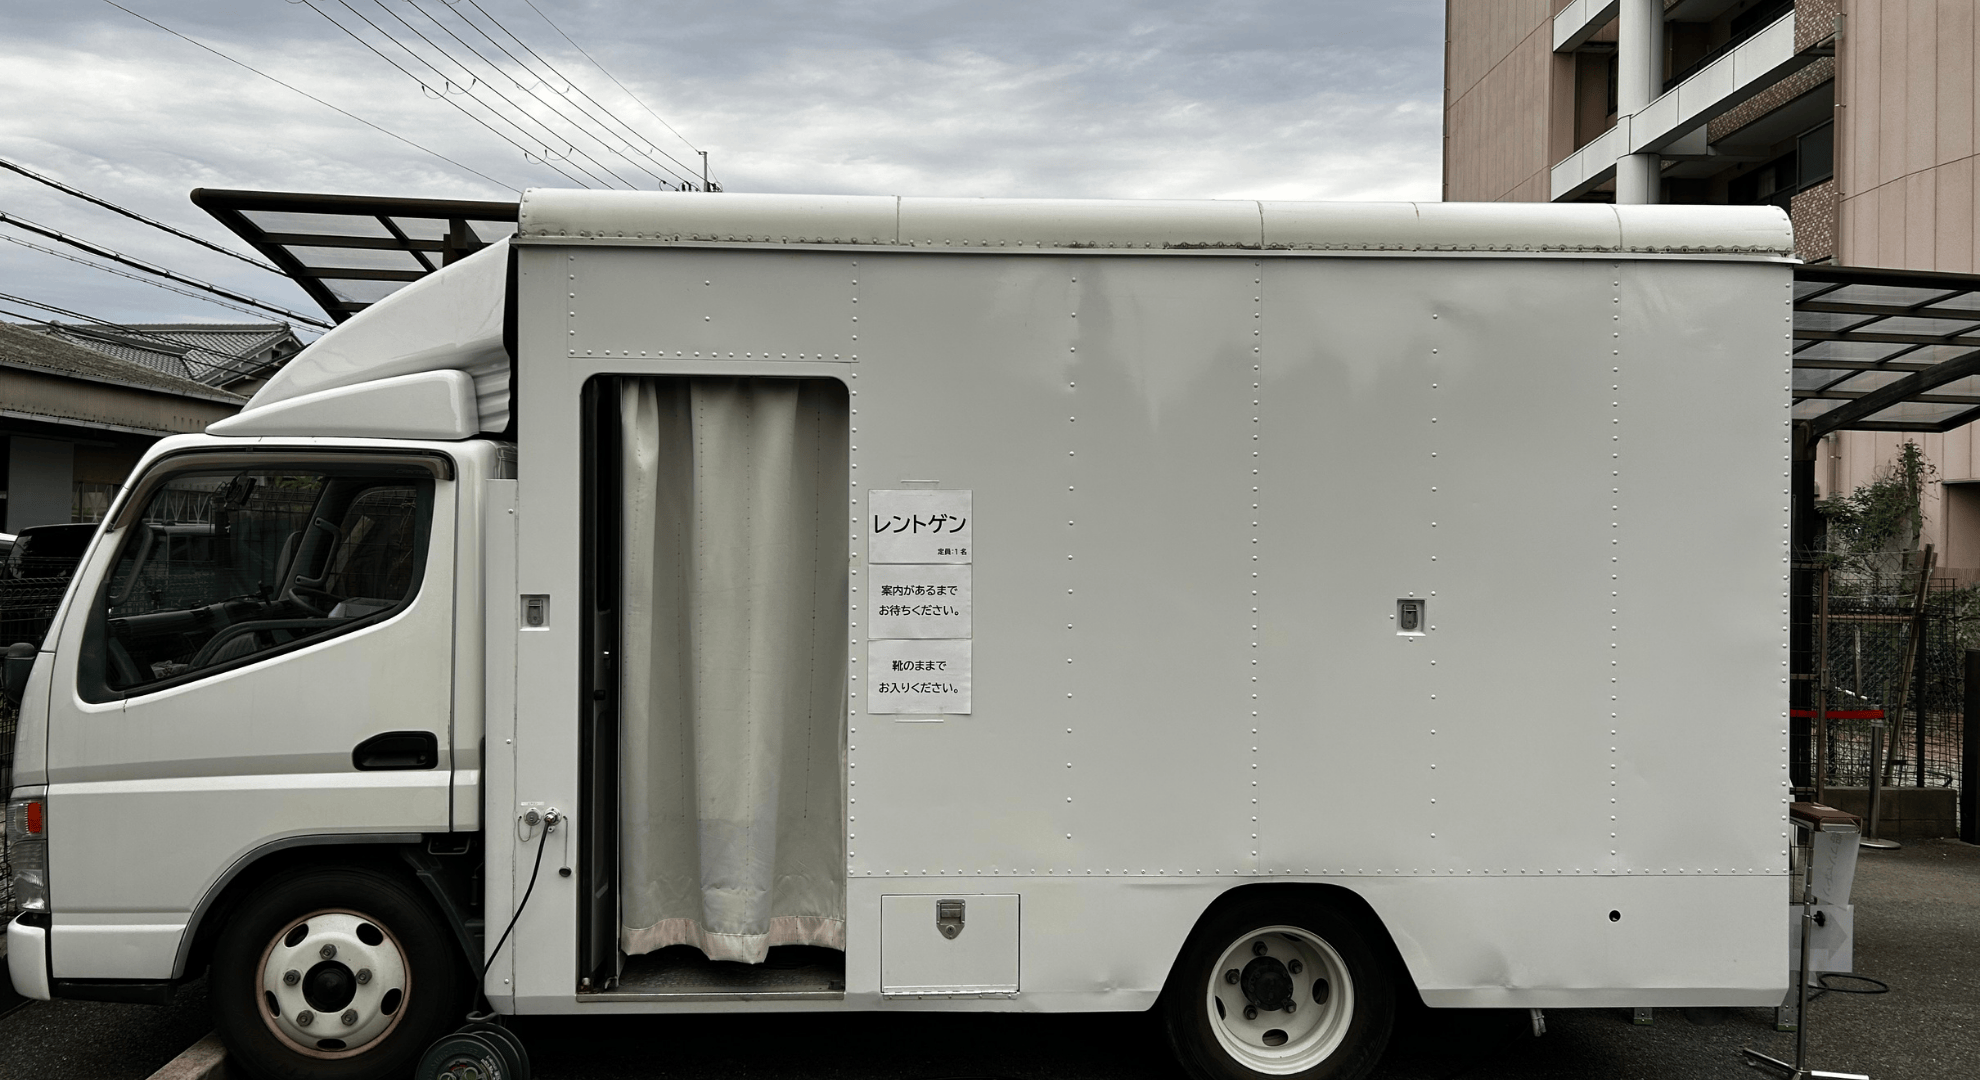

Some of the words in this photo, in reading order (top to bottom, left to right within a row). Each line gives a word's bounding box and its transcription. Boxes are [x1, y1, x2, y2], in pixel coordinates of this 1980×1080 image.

[874, 513, 967, 534] レントゲン
[881, 584, 959, 597] 案内があるまで
[878, 604, 960, 617] お待ちください。
[891, 660, 947, 672] 靴のままで
[878, 682, 959, 694] お入りください。
